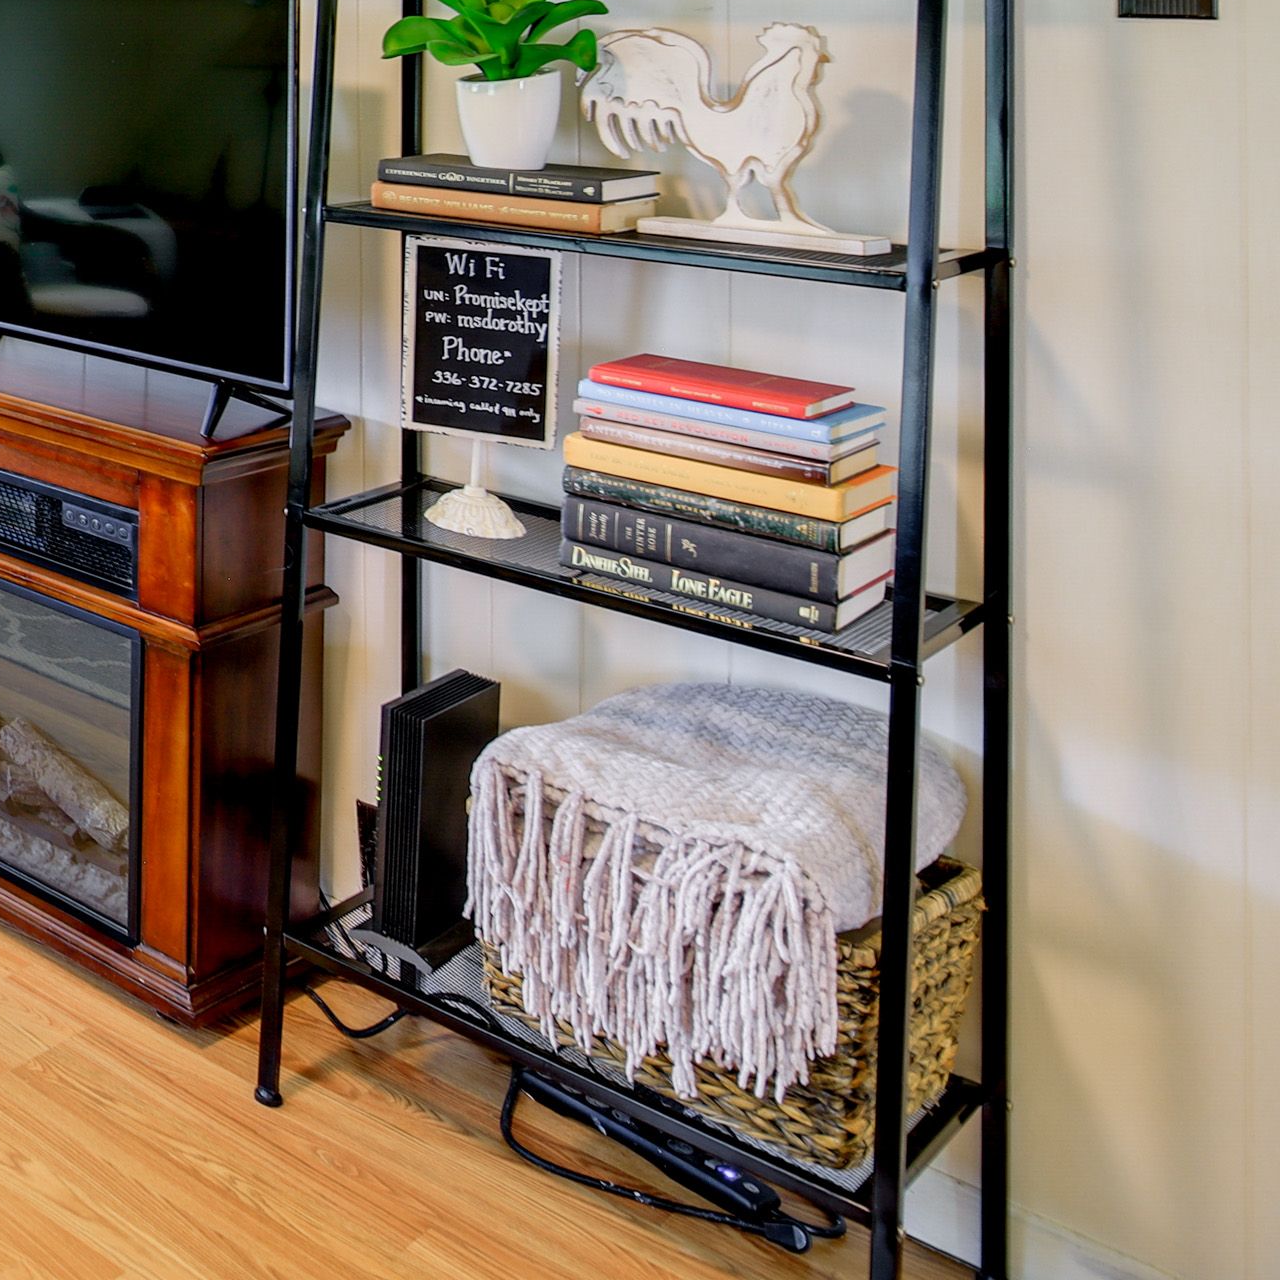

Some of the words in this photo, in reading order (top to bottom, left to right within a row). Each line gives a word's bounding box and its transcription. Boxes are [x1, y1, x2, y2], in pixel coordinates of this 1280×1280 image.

[385, 168, 437, 179] EXPERIENCING
[438, 171, 465, 182] GOD
[443, 200, 494, 211] WILLIAMS
[424, 289, 450, 302] UN:
[453, 284, 550, 318] Promisekept
[425, 311, 451, 324] PW:
[457, 308, 548, 342] msdorothy
[431, 370, 543, 396] 336-372-7285
[617, 557, 654, 583] STEEL
[671, 569, 707, 598] LONE
[707, 578, 753, 610] EAGLE
